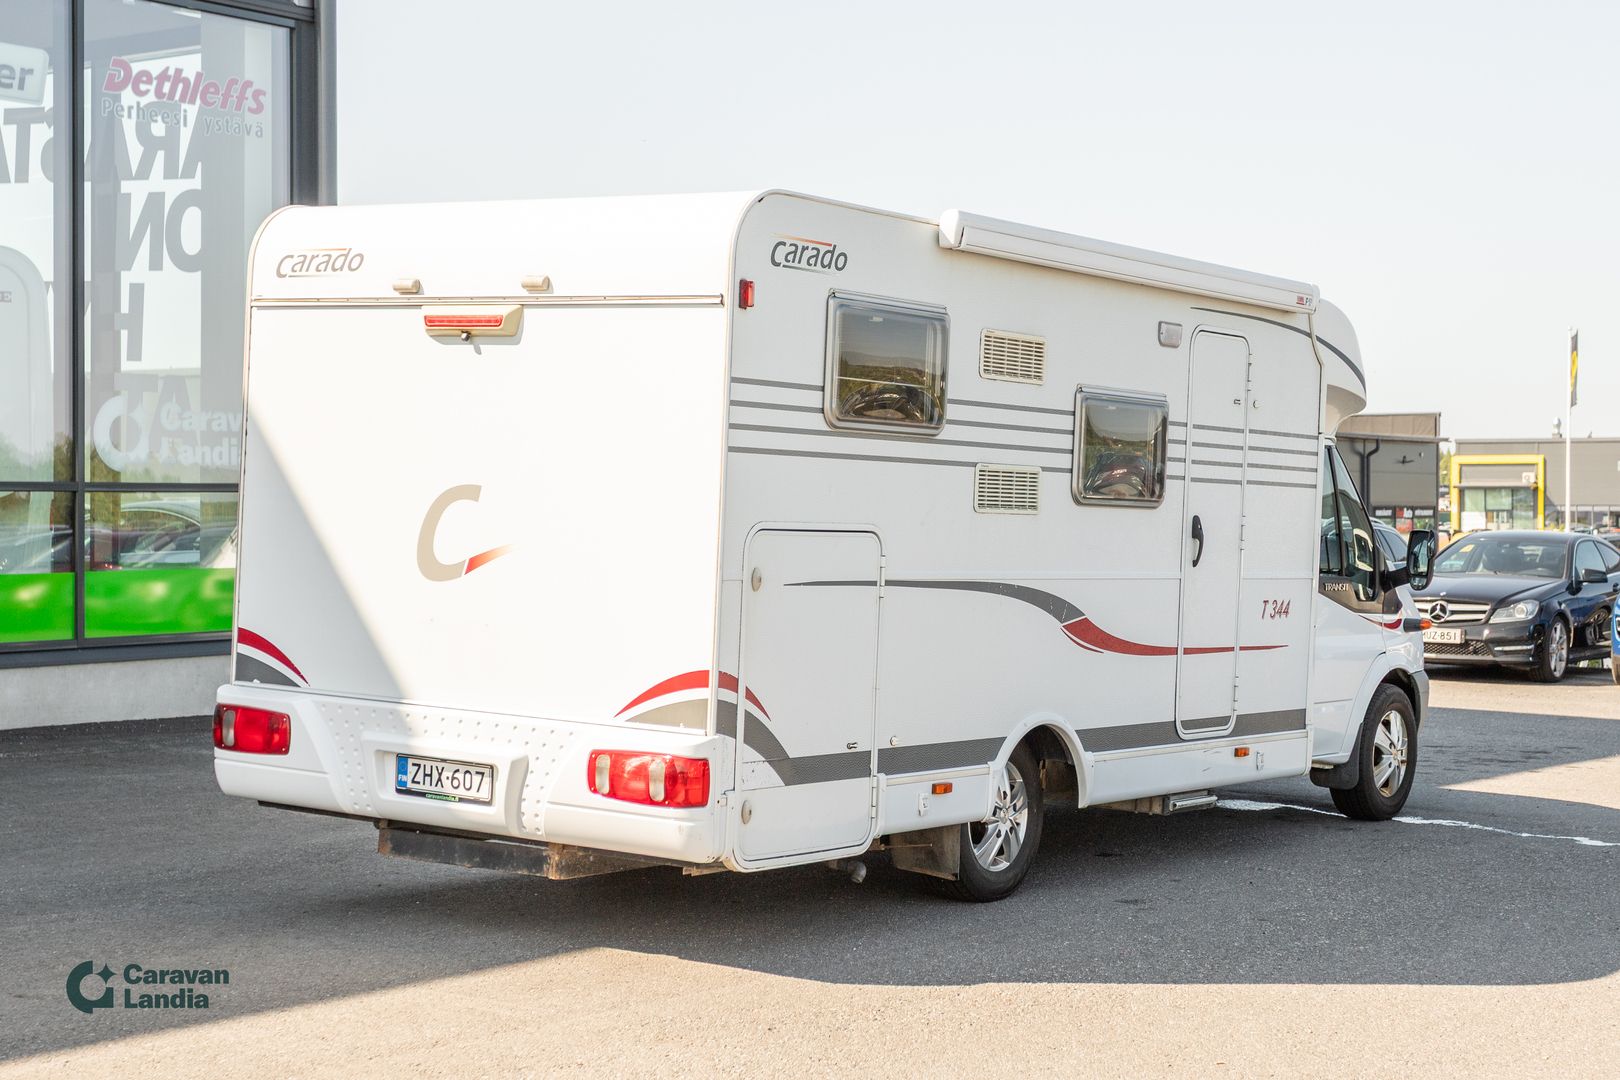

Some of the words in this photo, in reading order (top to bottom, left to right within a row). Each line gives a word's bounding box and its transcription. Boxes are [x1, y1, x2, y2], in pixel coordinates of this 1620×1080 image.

[103, 56, 267, 115] Dethleffs
[101, 97, 188, 128] Perheesi
[203, 117, 264, 138] ystävä
[160, 437, 240, 465] Landi
[1324, 583, 1349, 591] TRANSIT
[1261, 600, 1269, 620] T
[1270, 600, 1291, 620] 344
[411, 763, 485, 793] ZHX-607
